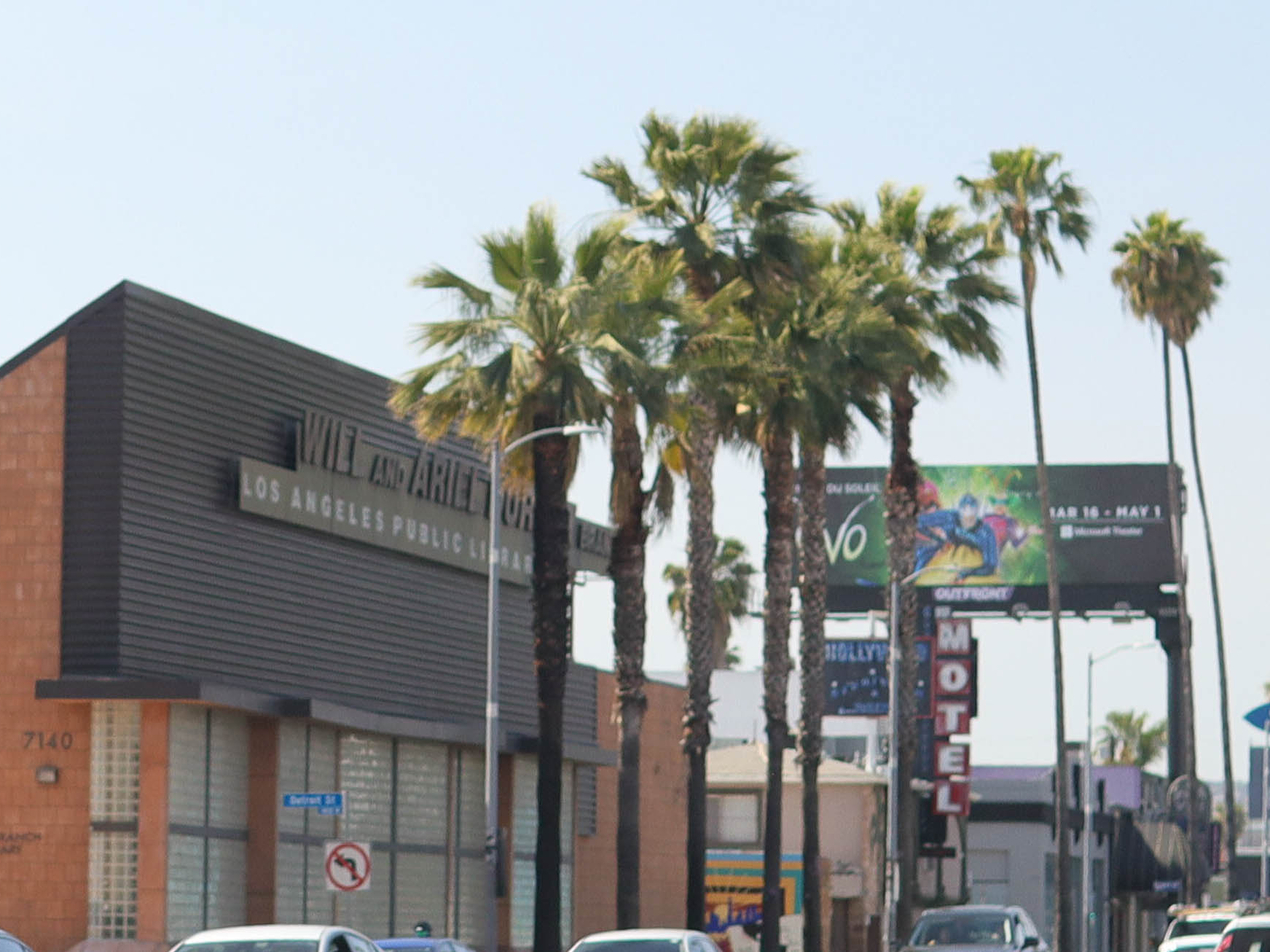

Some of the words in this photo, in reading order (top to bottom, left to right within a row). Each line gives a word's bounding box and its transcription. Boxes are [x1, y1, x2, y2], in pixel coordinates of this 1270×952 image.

[242, 472, 281, 503] LOS
[290, 486, 385, 533] ANGELES
[392, 514, 463, 553] PUBLIC
[469, 536, 535, 575] LIRAR
[1115, 504, 1149, 518] MAY
[1154, 504, 1161, 518] 1
[24, 731, 73, 750] 7140
[936, 620, 970, 814] MOTEL
